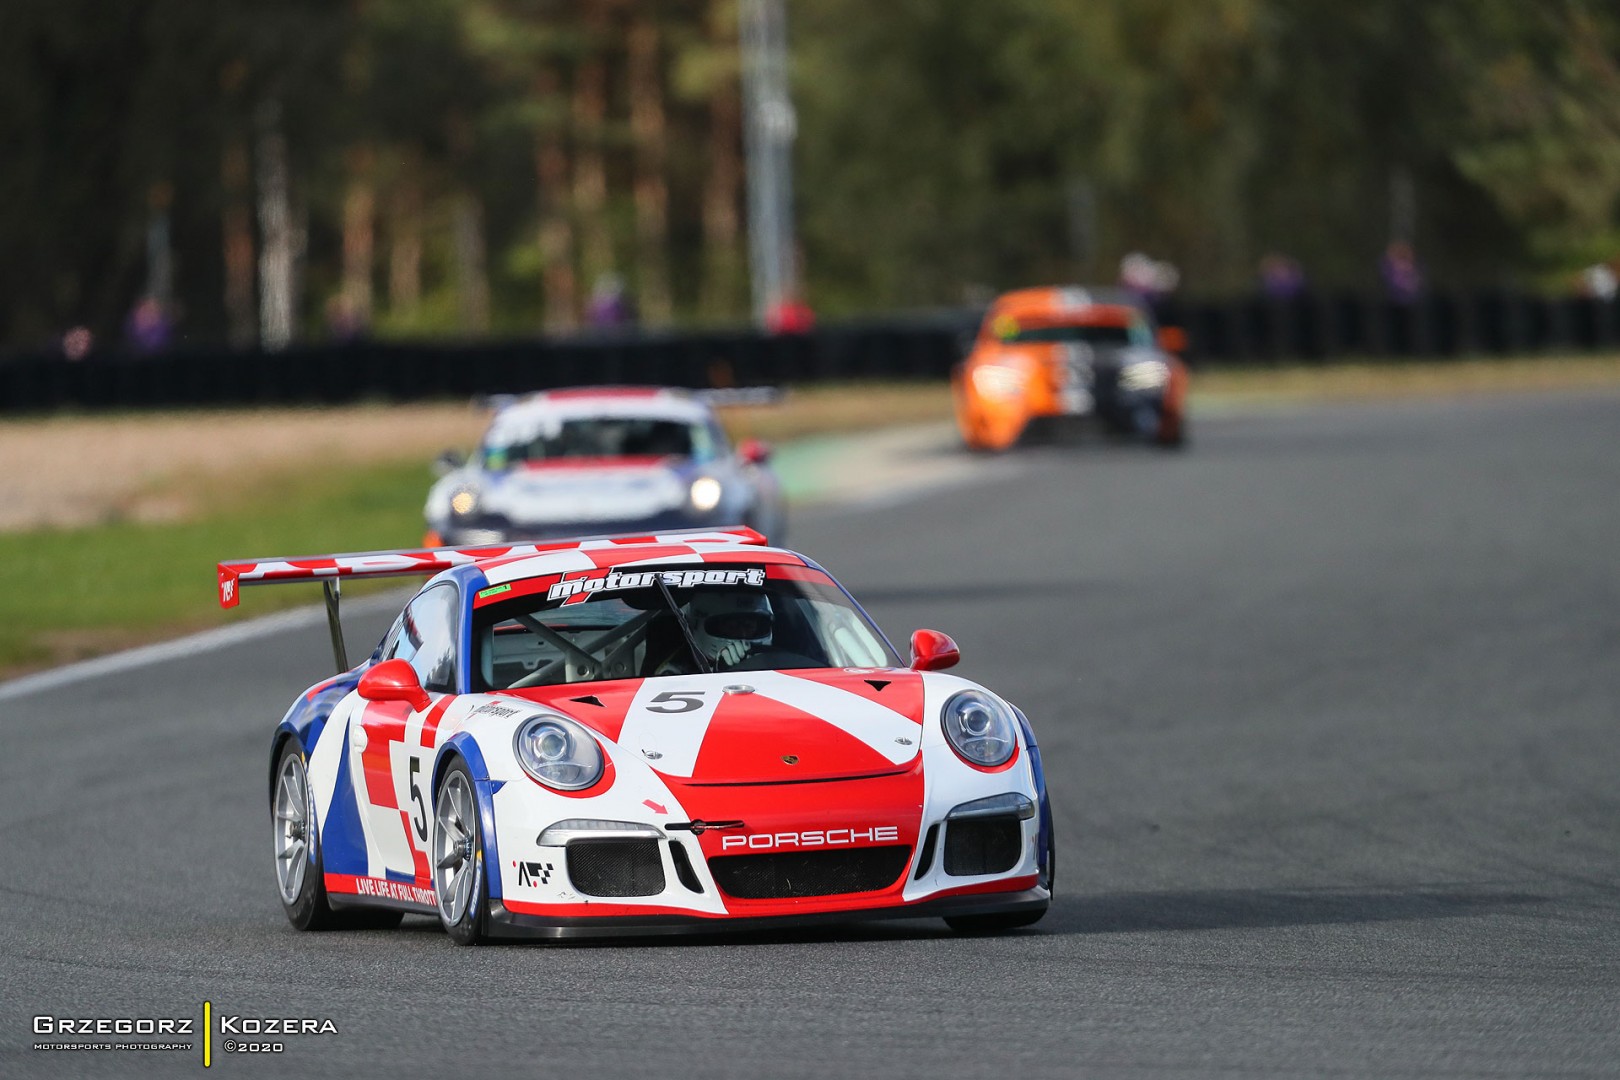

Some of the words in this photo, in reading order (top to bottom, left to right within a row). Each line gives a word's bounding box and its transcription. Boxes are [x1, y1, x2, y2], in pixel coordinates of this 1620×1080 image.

[547, 568, 766, 601] motorsport
[645, 691, 706, 714] 5
[410, 756, 428, 842] 5
[722, 826, 899, 850] PORSCHE
[356, 878, 375, 895] LIVE
[374, 880, 391, 898] LIFE
